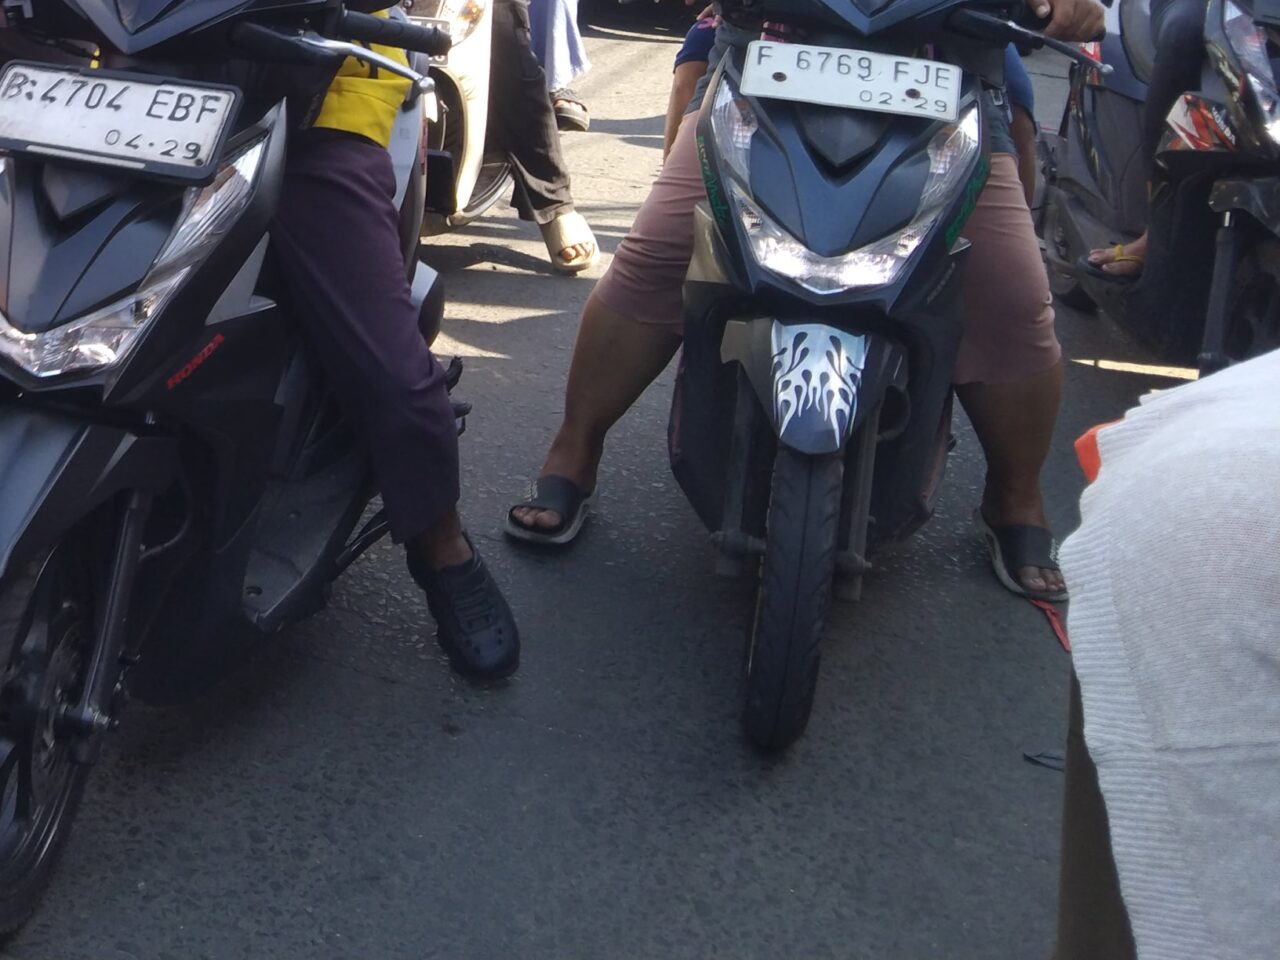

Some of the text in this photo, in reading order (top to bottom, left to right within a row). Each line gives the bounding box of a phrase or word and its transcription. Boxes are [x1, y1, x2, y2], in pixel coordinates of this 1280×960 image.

[757, 46, 951, 90] F 6769 FJE
[146, 89, 220, 124] EBF
